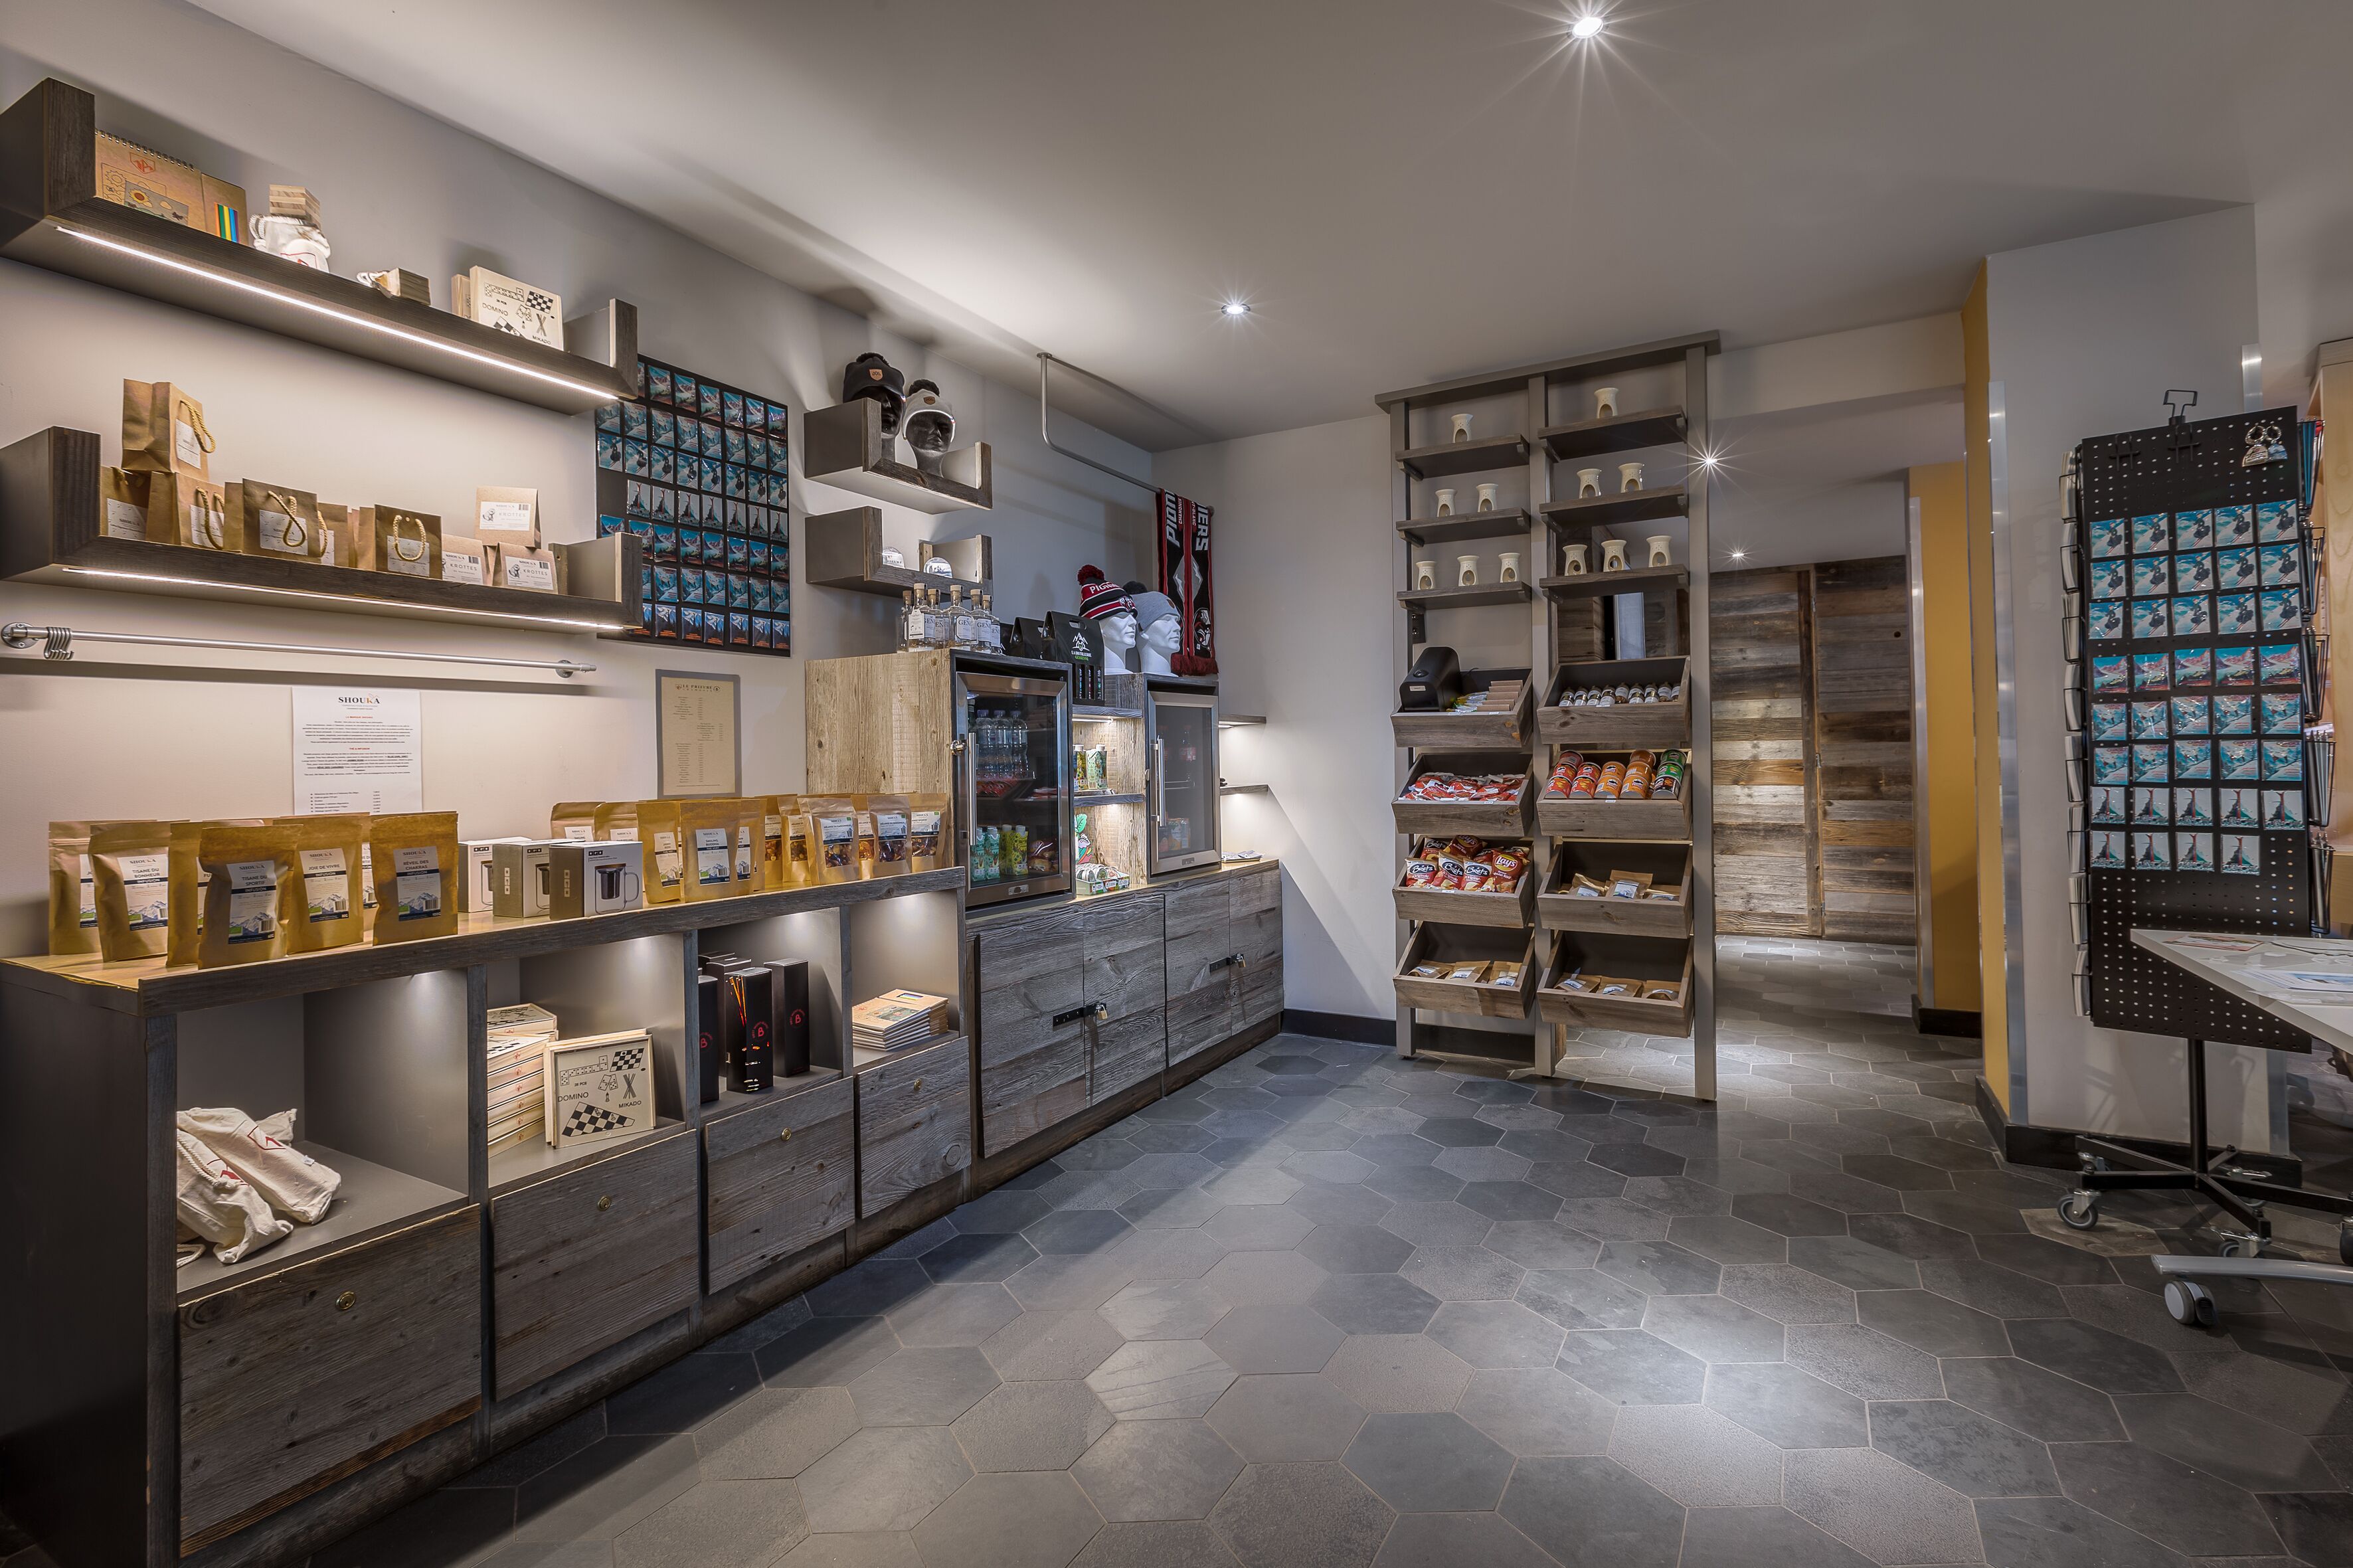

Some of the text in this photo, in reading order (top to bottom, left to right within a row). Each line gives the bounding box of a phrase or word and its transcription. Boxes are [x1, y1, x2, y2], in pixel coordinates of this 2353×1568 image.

[482, 302, 509, 316] DOMINO
[533, 335, 551, 345] MIKADO
[1496, 857, 1516, 867] Lay's
[557, 1092, 589, 1102] DOMINO
